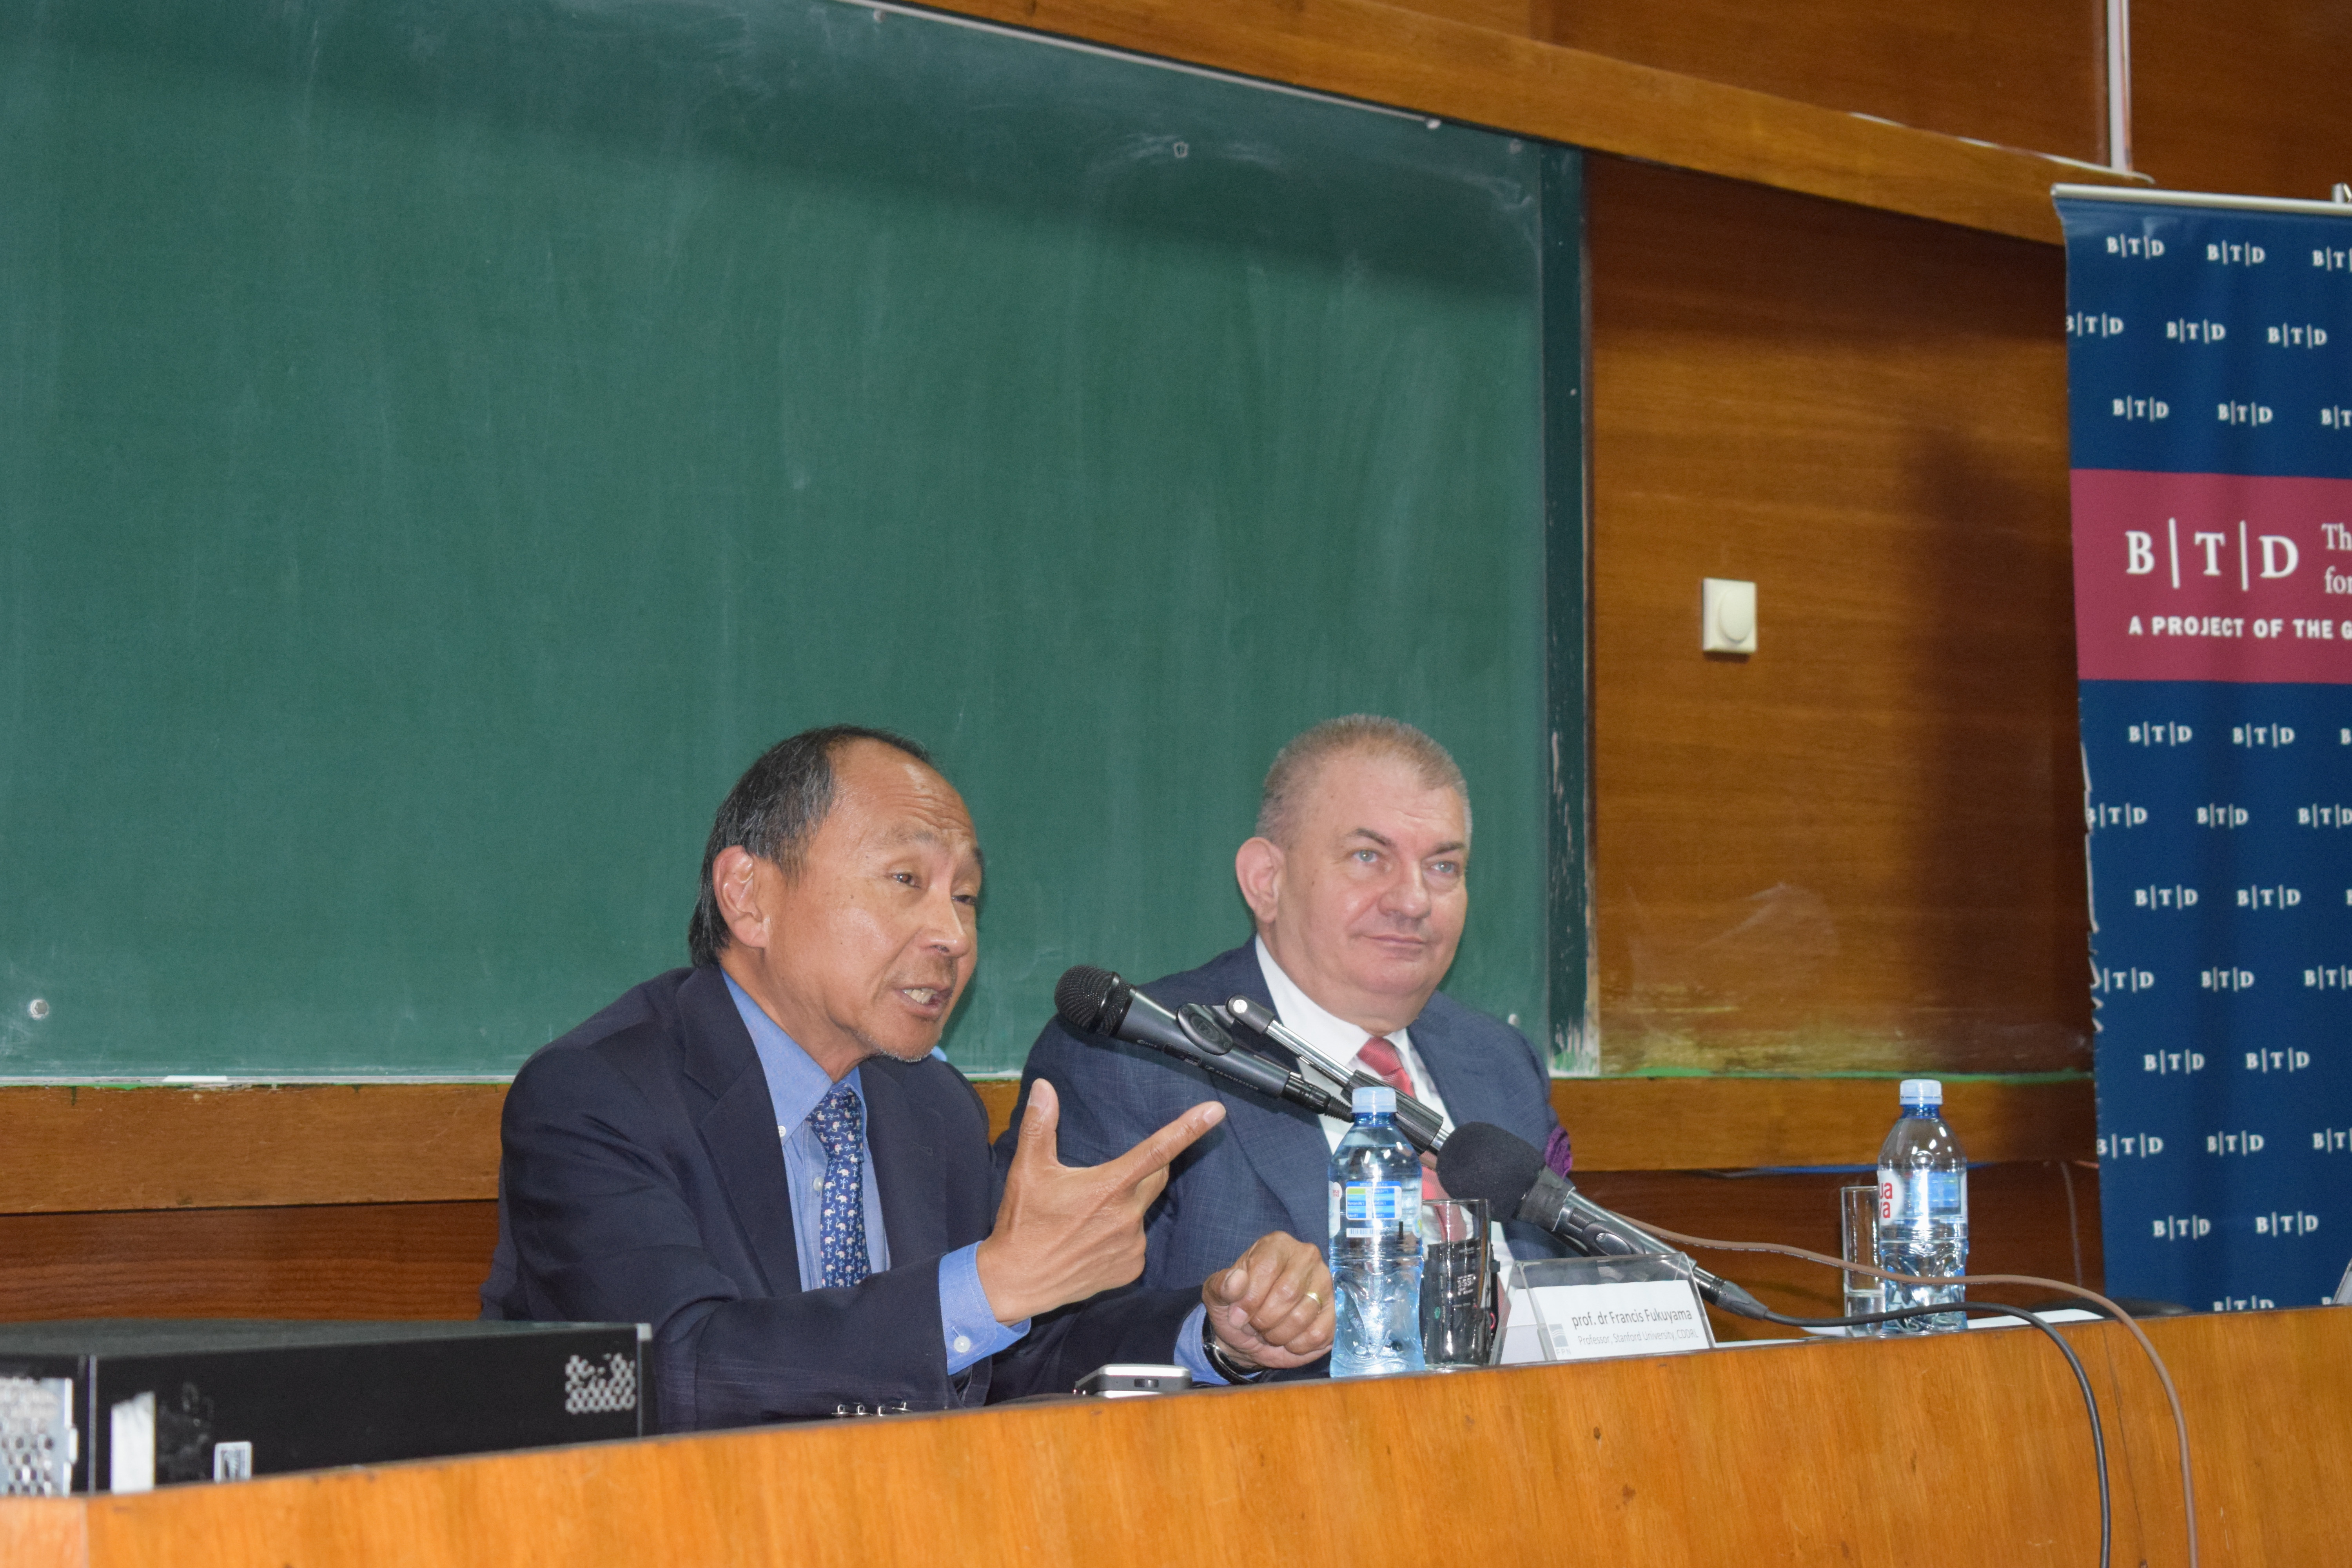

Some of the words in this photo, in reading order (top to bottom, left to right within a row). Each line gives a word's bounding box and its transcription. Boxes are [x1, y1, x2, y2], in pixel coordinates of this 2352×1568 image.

[2129, 616, 2143, 635] A
[2152, 616, 2244, 637] PROJECT
[2253, 619, 2283, 638] OF
[2292, 619, 2333, 639] THE
[1571, 1311, 1596, 1330] prof.
[1598, 1311, 1608, 1325] dr
[1609, 1309, 1644, 1324] Francis
[1644, 1308, 1693, 1323] Fukuyama
[1578, 1334, 1613, 1345] Professor,
[1613, 1331, 1642, 1343] Stanford
[1642, 1330, 1677, 1341] University,
